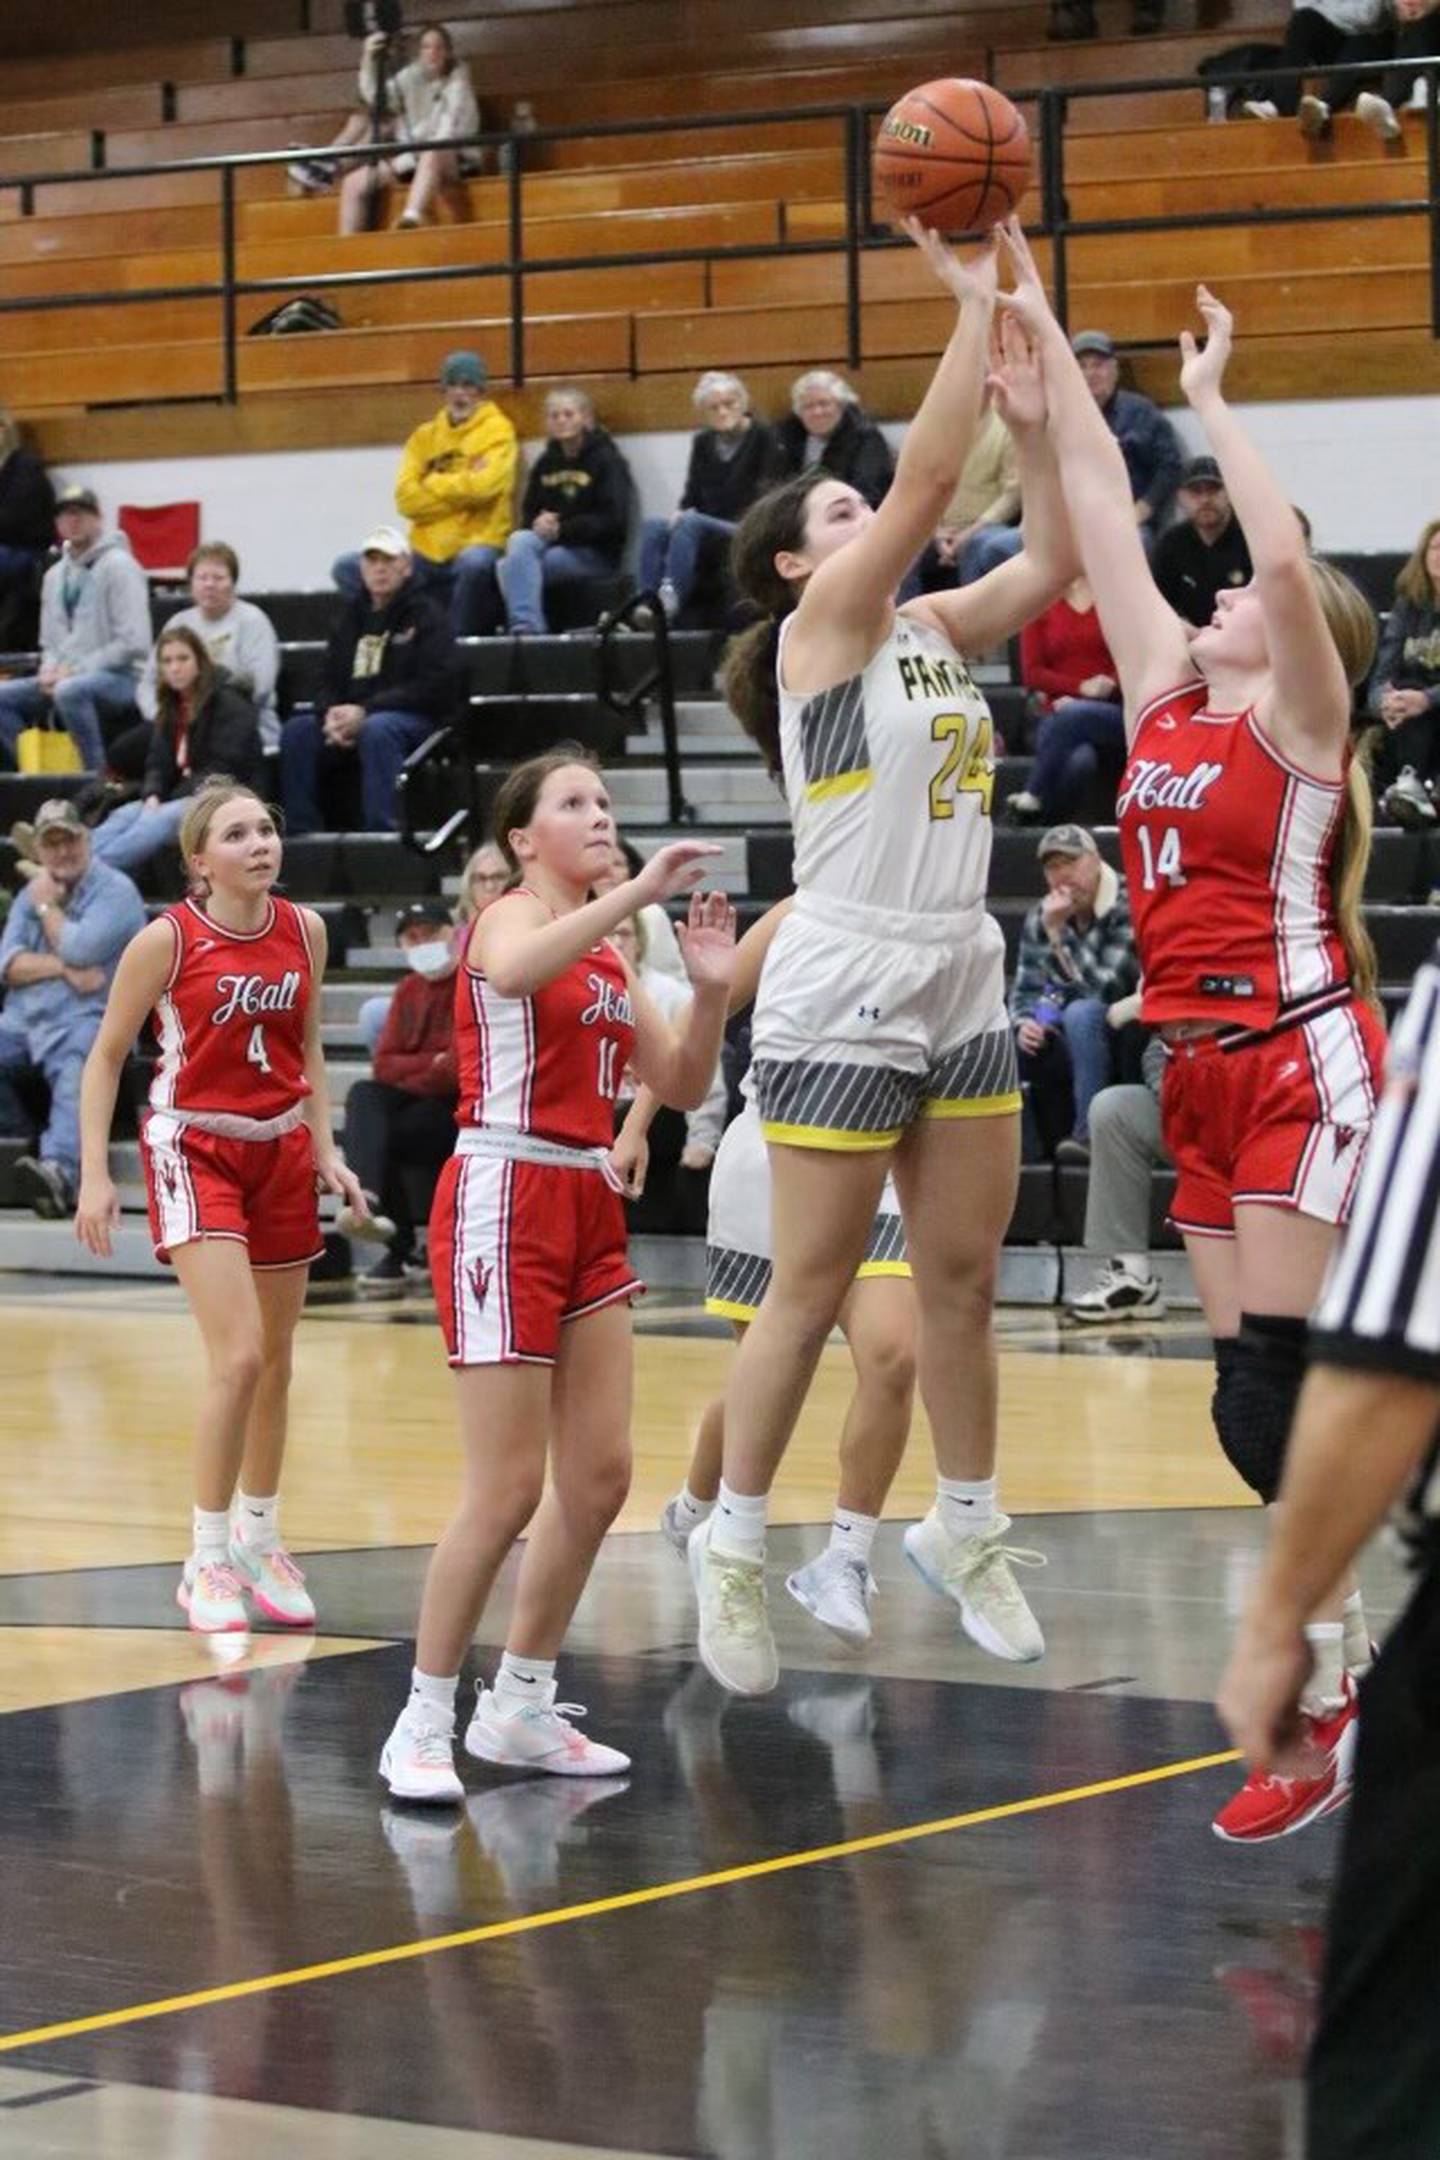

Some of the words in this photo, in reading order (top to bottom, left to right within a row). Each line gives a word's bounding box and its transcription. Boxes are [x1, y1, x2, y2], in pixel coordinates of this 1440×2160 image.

[929, 713, 994, 820] 24
[1115, 759, 1223, 819] Hall
[1137, 824, 1187, 890] 14
[211, 970, 300, 1025] Hall
[246, 1023, 272, 1073] 4
[597, 1036, 618, 1100] 11
